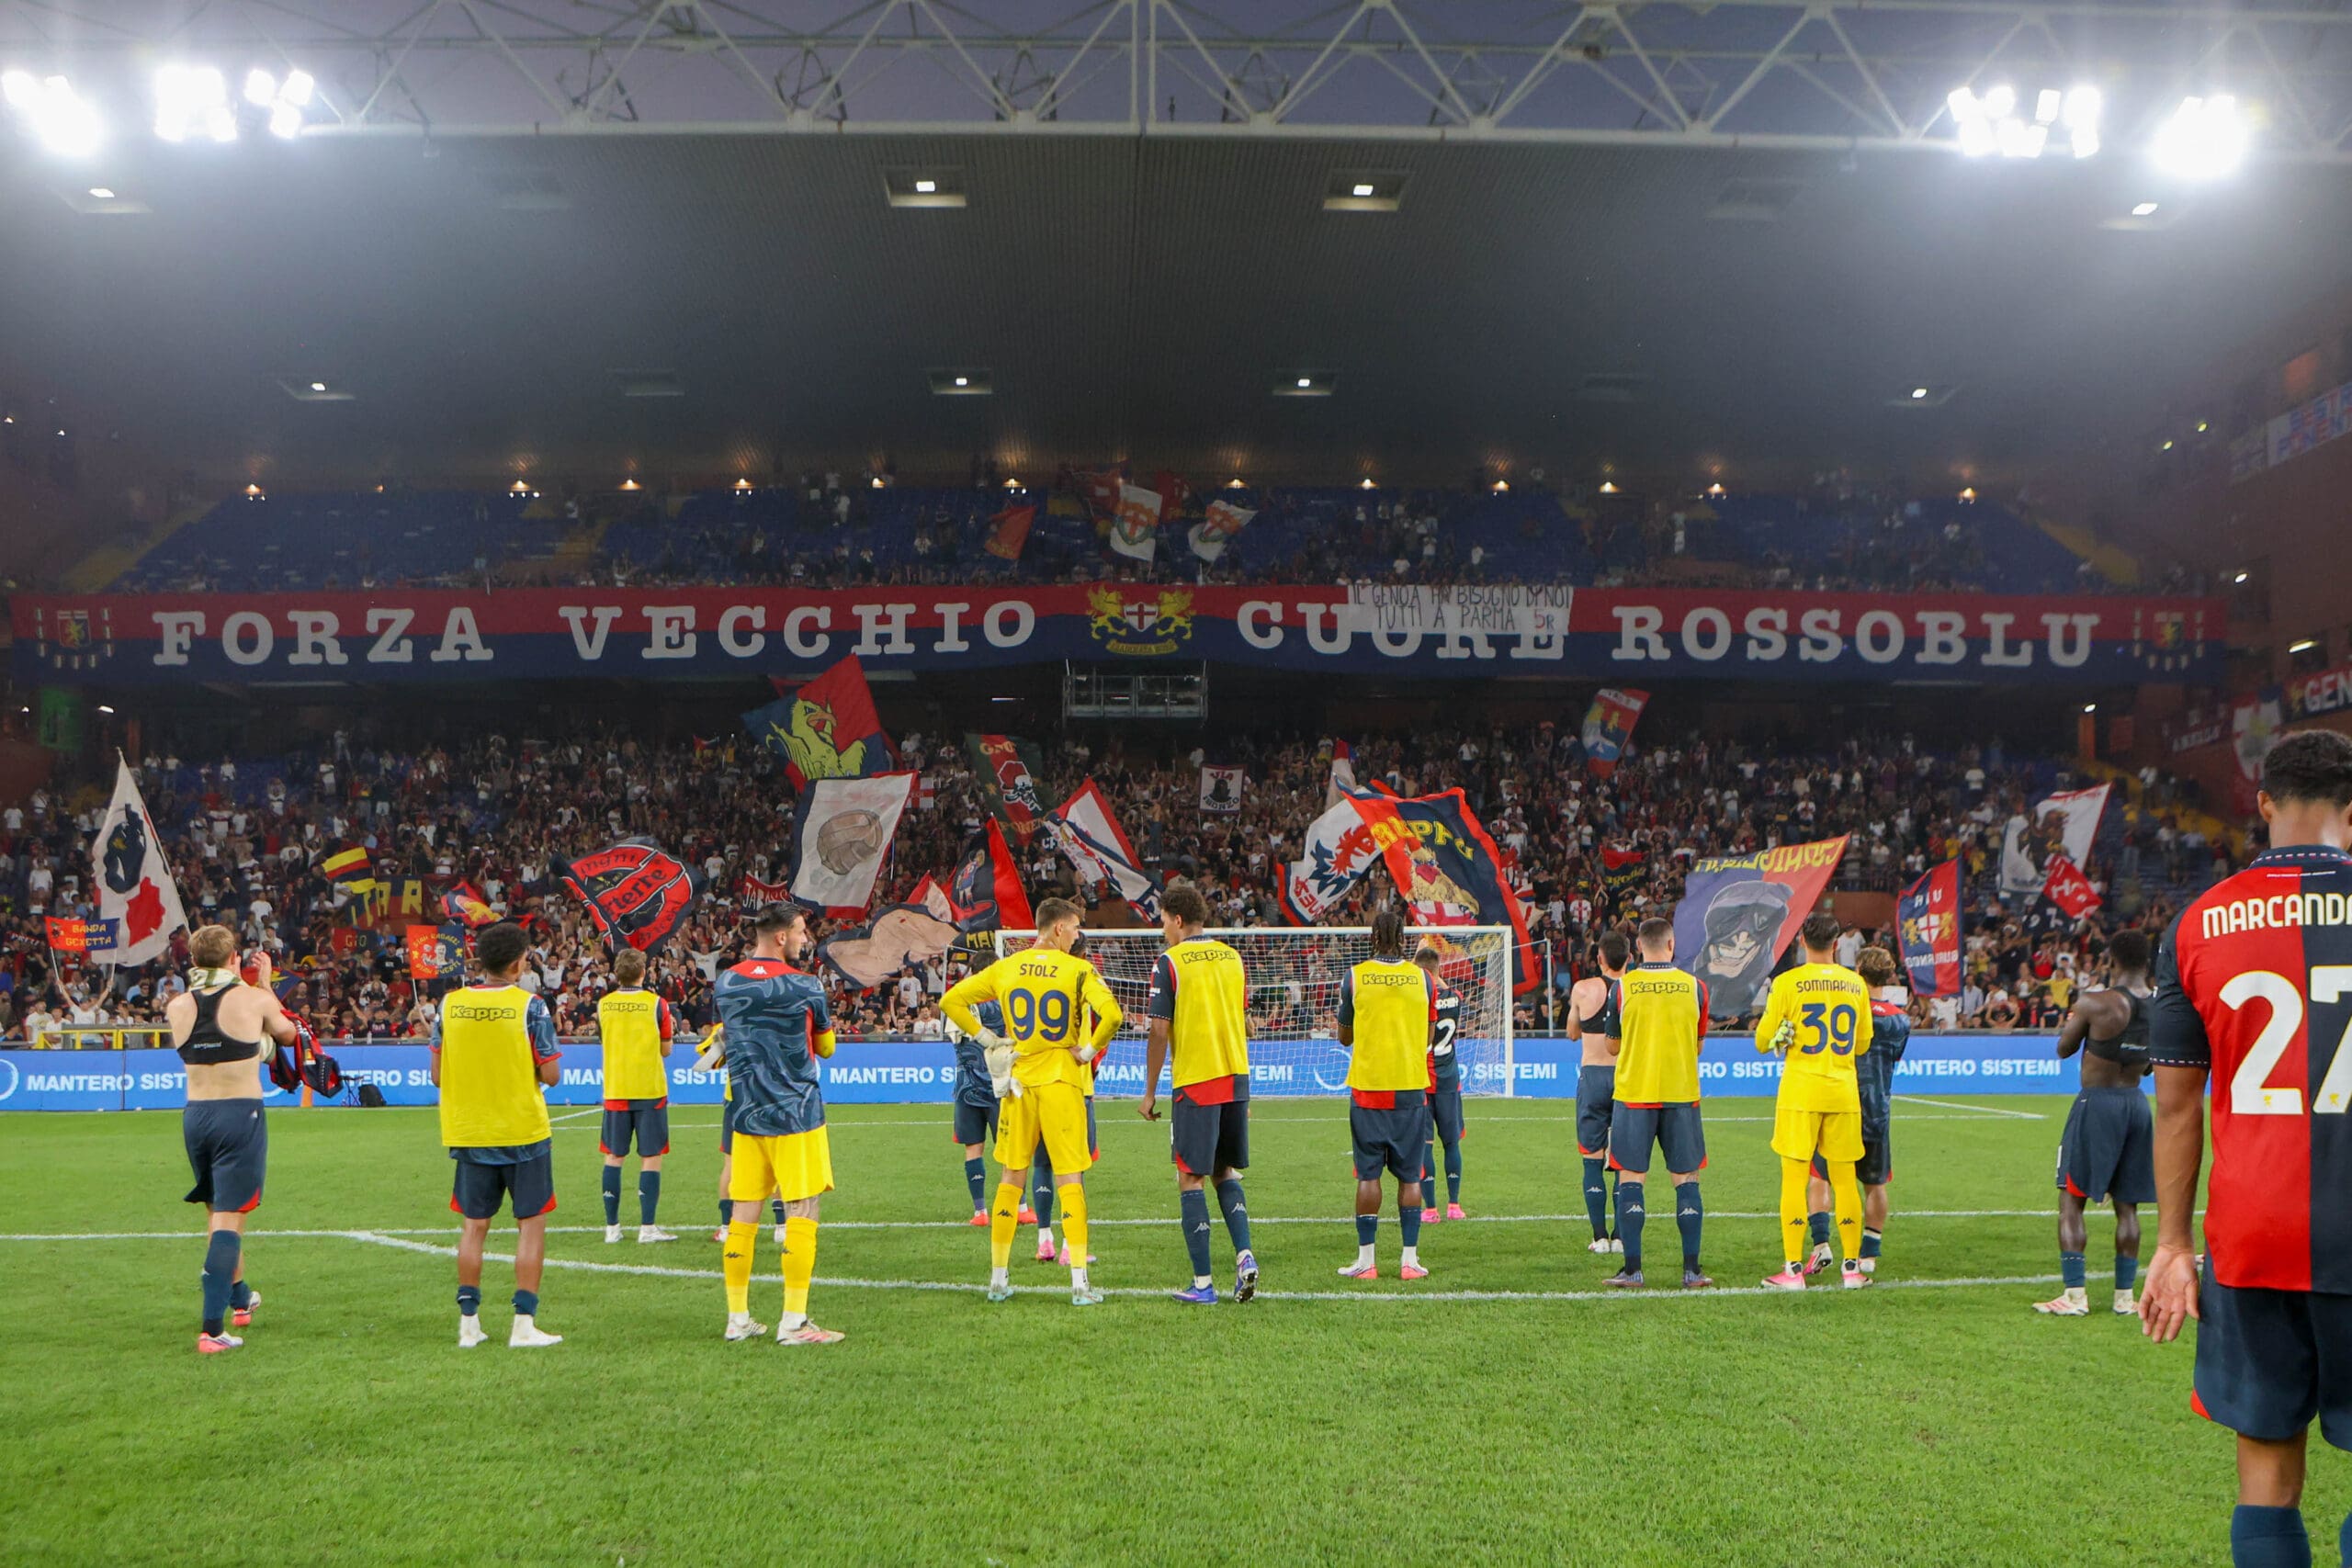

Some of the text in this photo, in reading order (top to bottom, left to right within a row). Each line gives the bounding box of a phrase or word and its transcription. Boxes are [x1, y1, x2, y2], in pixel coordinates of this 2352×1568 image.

[1372, 584, 1420, 606] GENOA
[1457, 584, 1521, 607] BISOGNO
[1376, 602, 1516, 630] TUTTI A PARMA
[152, 606, 494, 667] FORZA
[558, 600, 1036, 660] VECCHIO
[1611, 604, 2101, 668] ROSSOBLU
[72, 923, 107, 934] BANDA
[1180, 949, 1238, 965] Kappa
[1019, 963, 1058, 978] STOLZ
[1362, 973, 1419, 987] Kappa
[1629, 979, 1690, 995] Kappa
[1795, 975, 1862, 997] SOMMARIVA
[449, 1005, 517, 1022] Kappa
[602, 1000, 650, 1013] Kappa
[1008, 987, 1070, 1043] 99
[1427, 1018, 1457, 1056] 2
[1800, 1002, 1858, 1056] 39
[2218, 964, 2352, 1116] 27
[673, 1067, 729, 1085] SISTE
[830, 1067, 934, 1084] MANTERO
[1731, 1061, 1785, 1079] SISTE
[1896, 1058, 2062, 1077] ANTERO SISTEMI
[27, 1072, 187, 1091] MANTERO SIST
[340, 1068, 402, 1087] TERO
